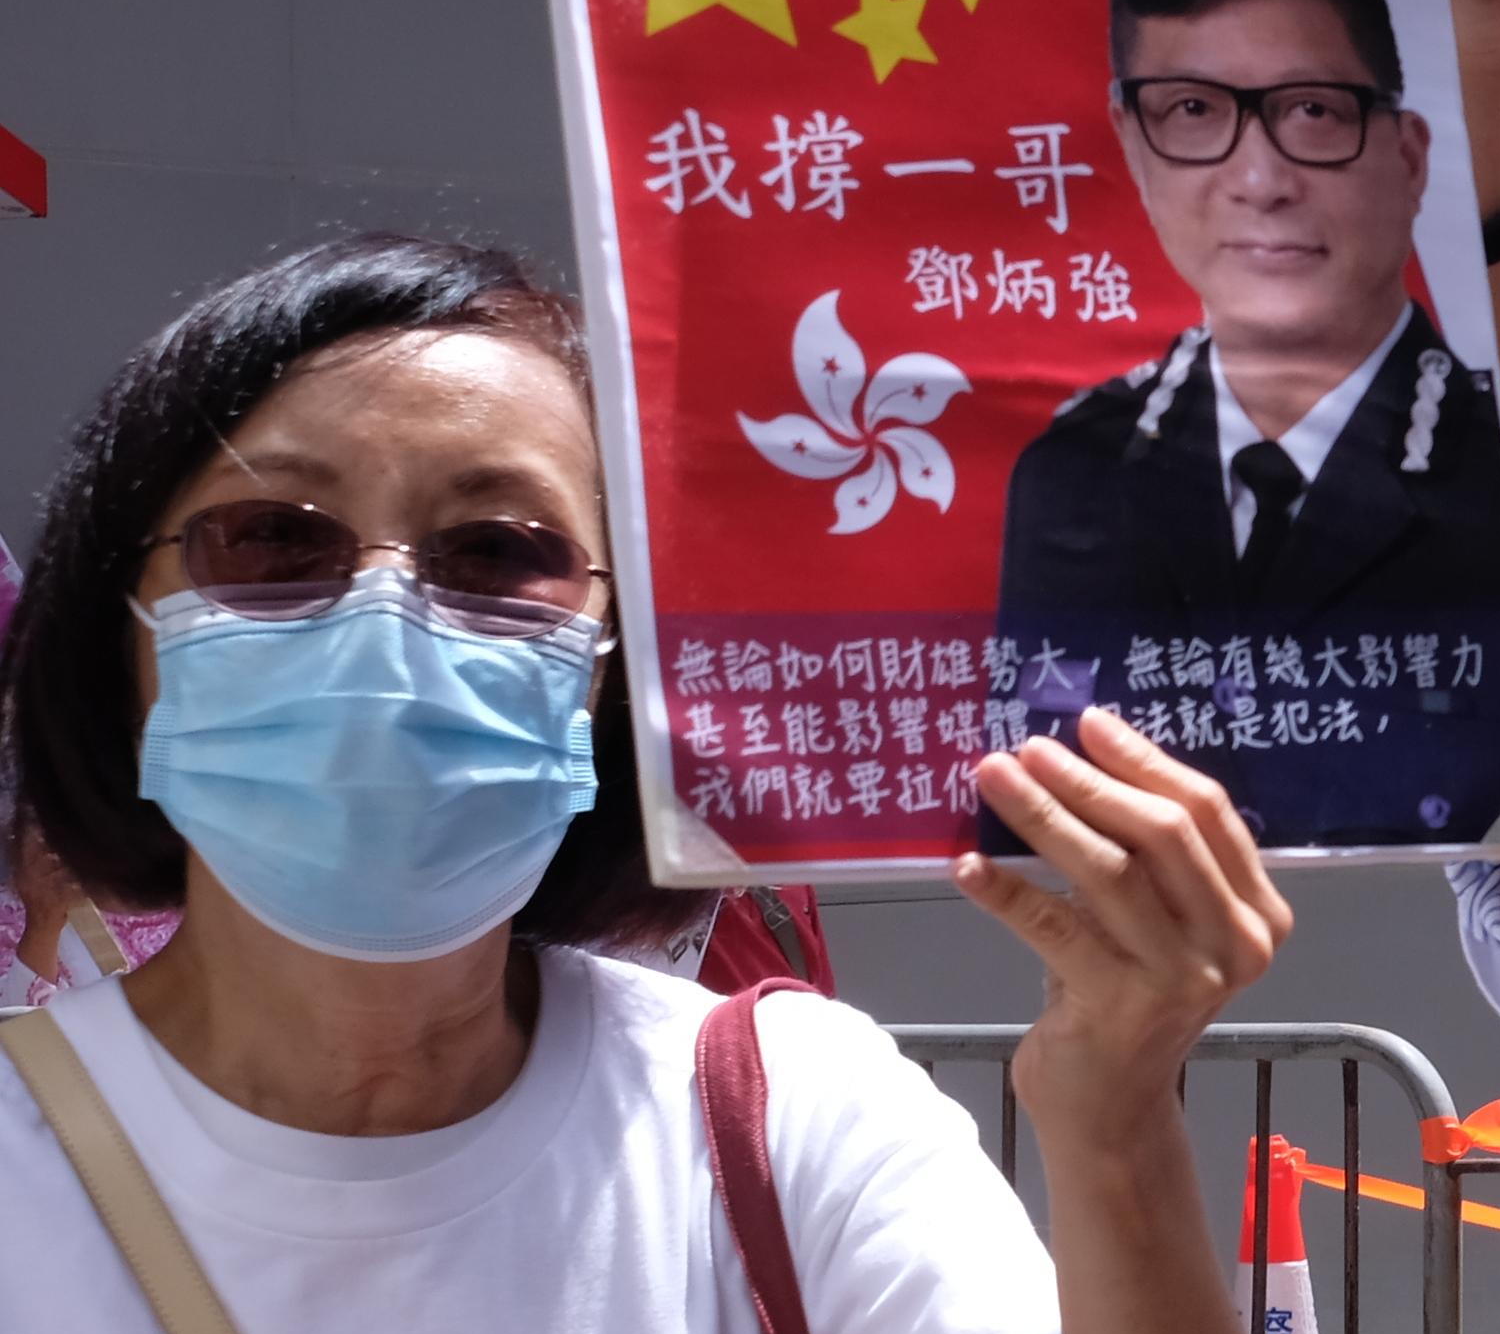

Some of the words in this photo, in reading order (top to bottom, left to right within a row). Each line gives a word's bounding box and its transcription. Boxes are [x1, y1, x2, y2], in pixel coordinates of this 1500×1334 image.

[643, 107, 1096, 237] 我撐一哥
[903, 244, 1140, 328] 鄧炳強
